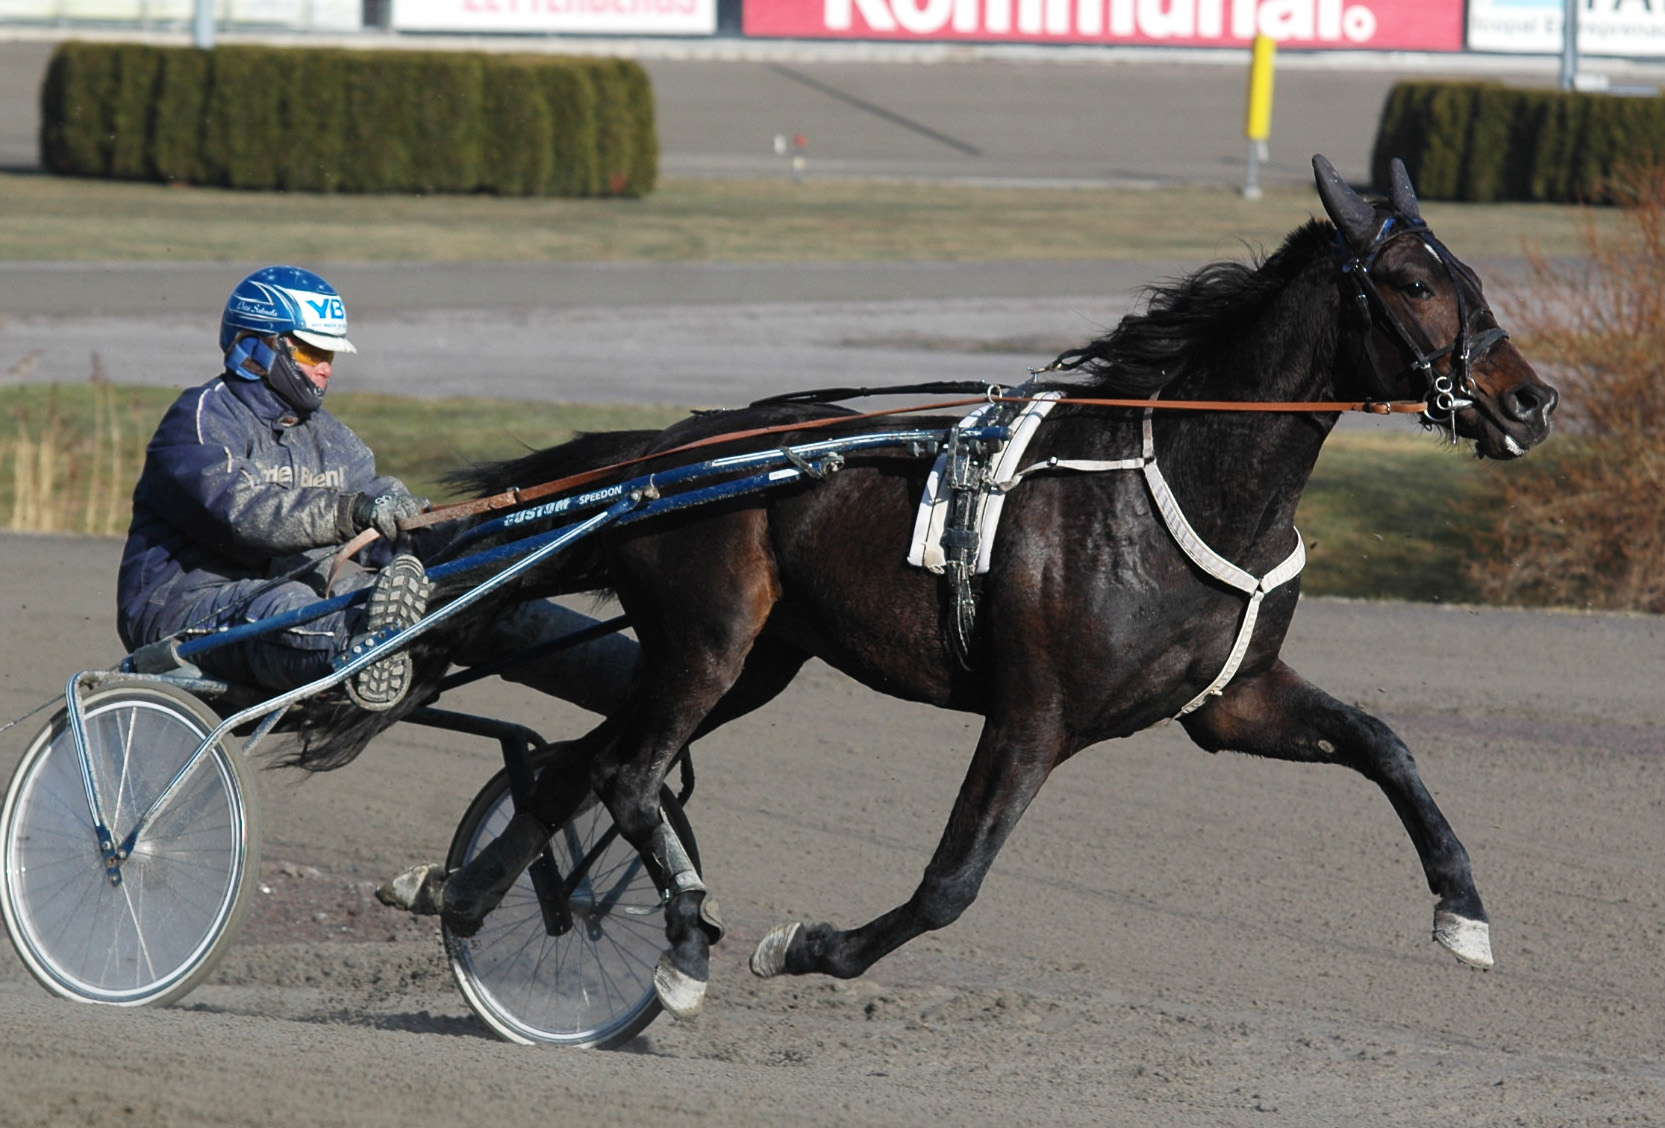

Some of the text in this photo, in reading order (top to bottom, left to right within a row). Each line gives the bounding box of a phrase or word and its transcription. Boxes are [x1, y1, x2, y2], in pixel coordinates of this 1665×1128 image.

[305, 298, 345, 320] YB
[504, 485, 622, 526] CUSTOM SPEEDON
